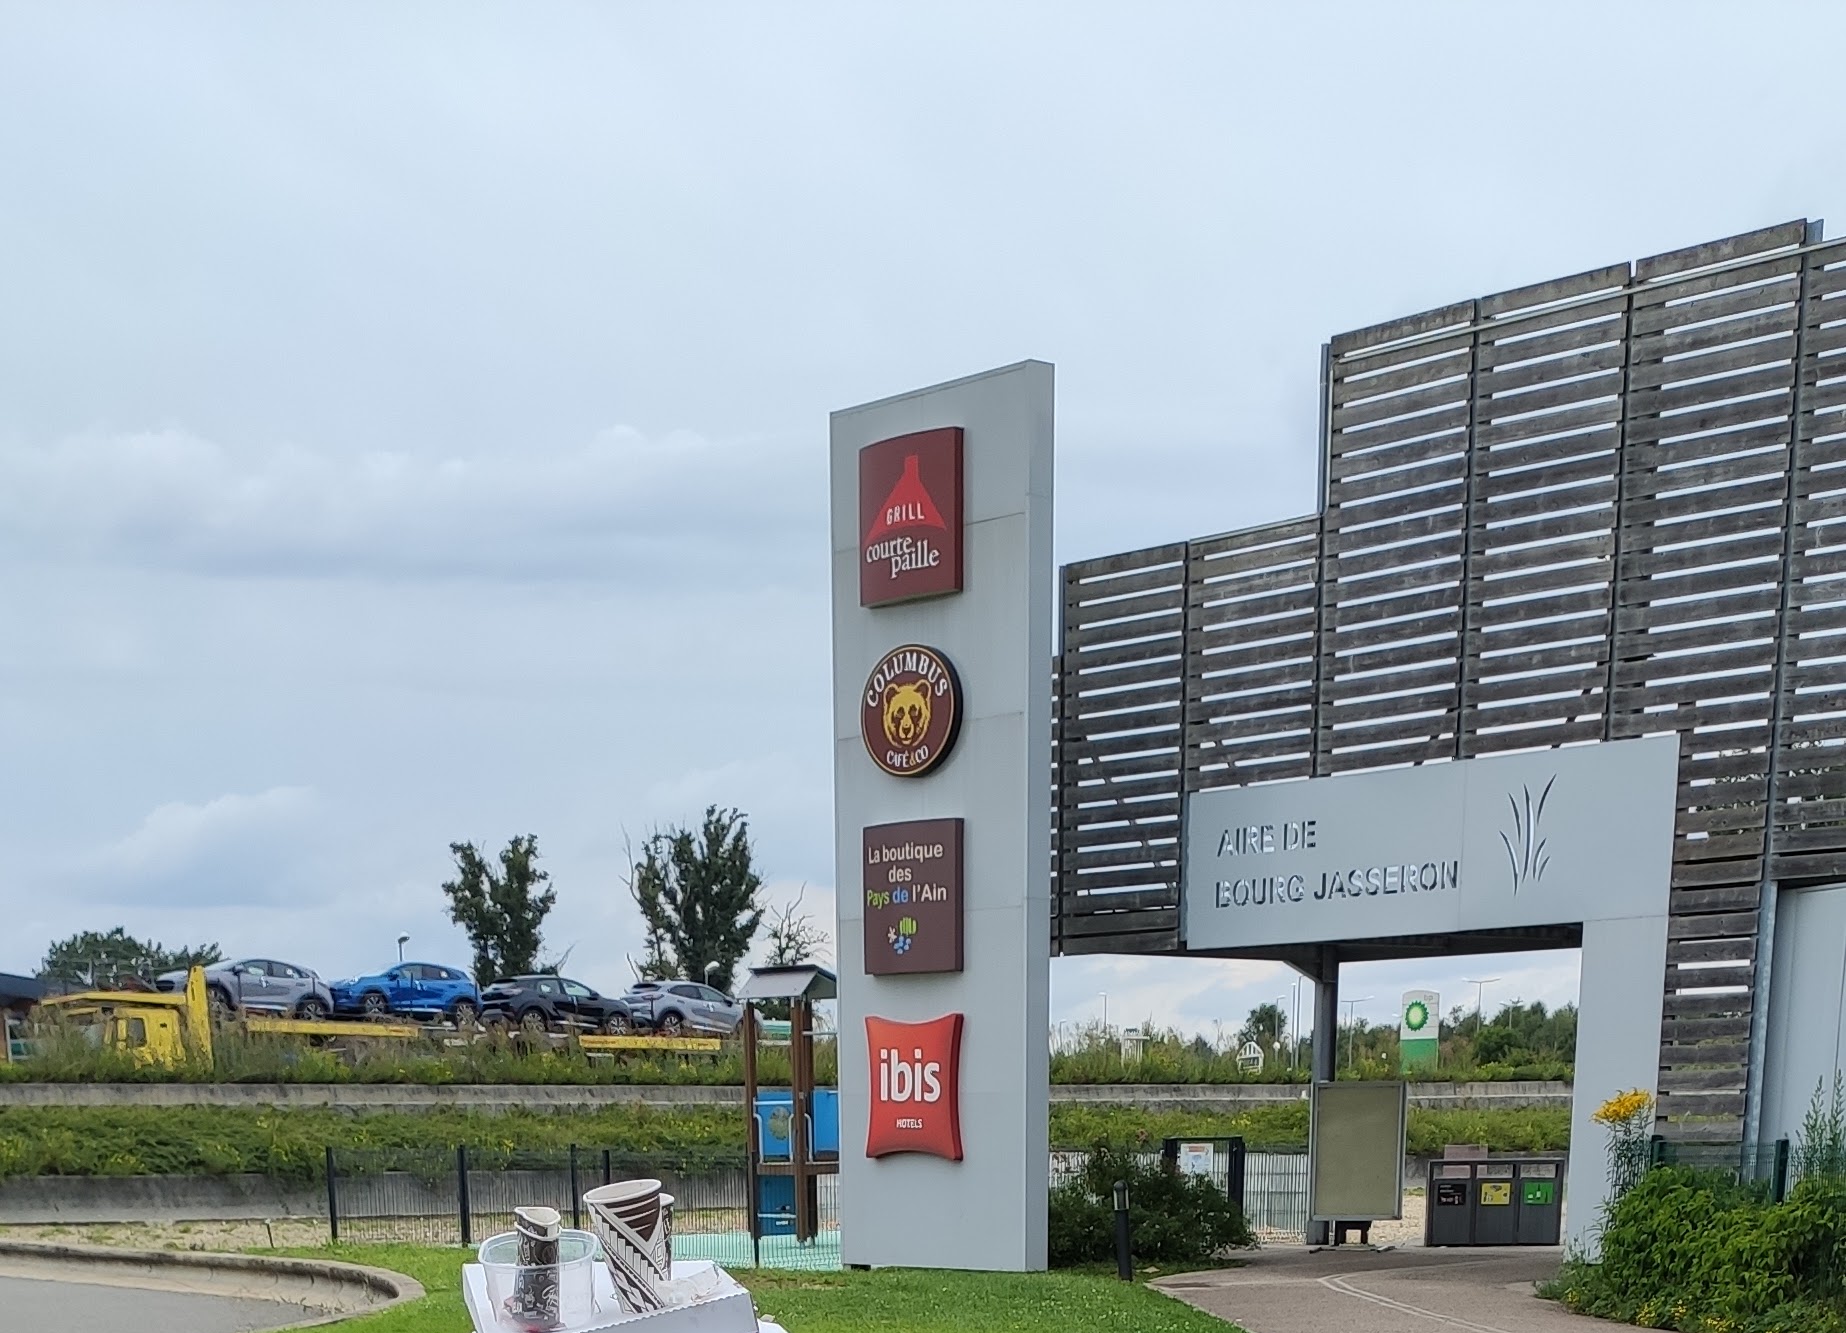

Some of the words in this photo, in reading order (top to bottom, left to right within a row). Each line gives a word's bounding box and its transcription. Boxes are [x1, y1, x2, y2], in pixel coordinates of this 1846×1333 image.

[886, 501, 925, 525] GRILL
[866, 536, 916, 564] courte
[889, 538, 940, 579] paille
[867, 652, 948, 708] COLUMBUS
[868, 846, 881, 864] La
[882, 841, 944, 863] boutique
[1217, 824, 1276, 857] AIRE
[1282, 820, 1317, 852] DE
[888, 864, 912, 883] des
[1215, 874, 1305, 909] BOURG
[1313, 859, 1459, 901] JASSERON
[867, 889, 890, 909] Pays
[892, 886, 909, 904] de
[912, 883, 947, 903] l'Ain
[880, 1048, 941, 1103] ibis
[896, 1118, 923, 1129] HOTELS
